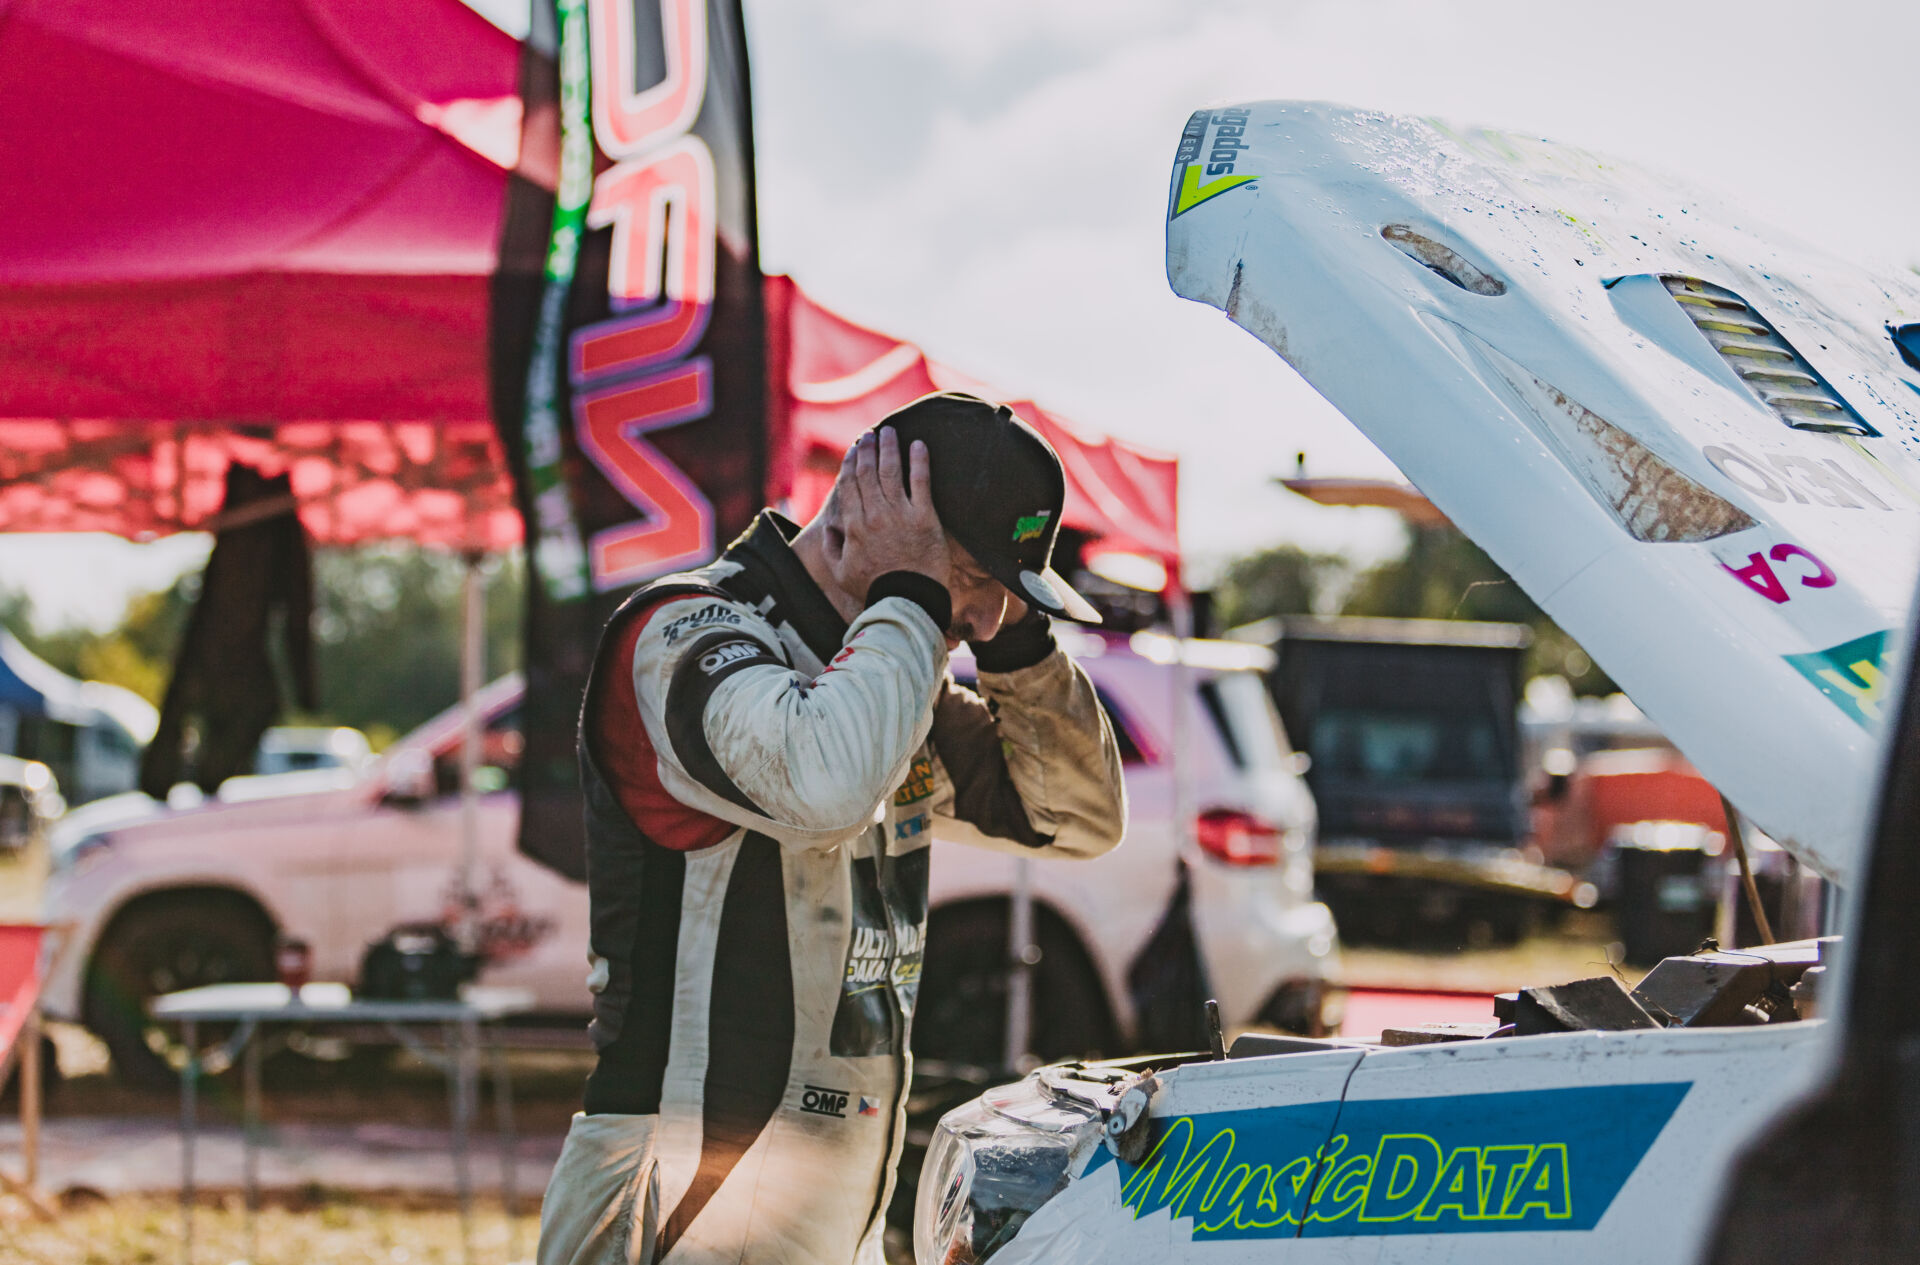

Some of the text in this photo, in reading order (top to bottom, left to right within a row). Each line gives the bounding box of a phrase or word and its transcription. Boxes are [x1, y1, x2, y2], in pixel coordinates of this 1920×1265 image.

[1206, 108, 1251, 176] agados
[699, 643, 761, 672] OMP
[801, 1088, 848, 1114] OMP
